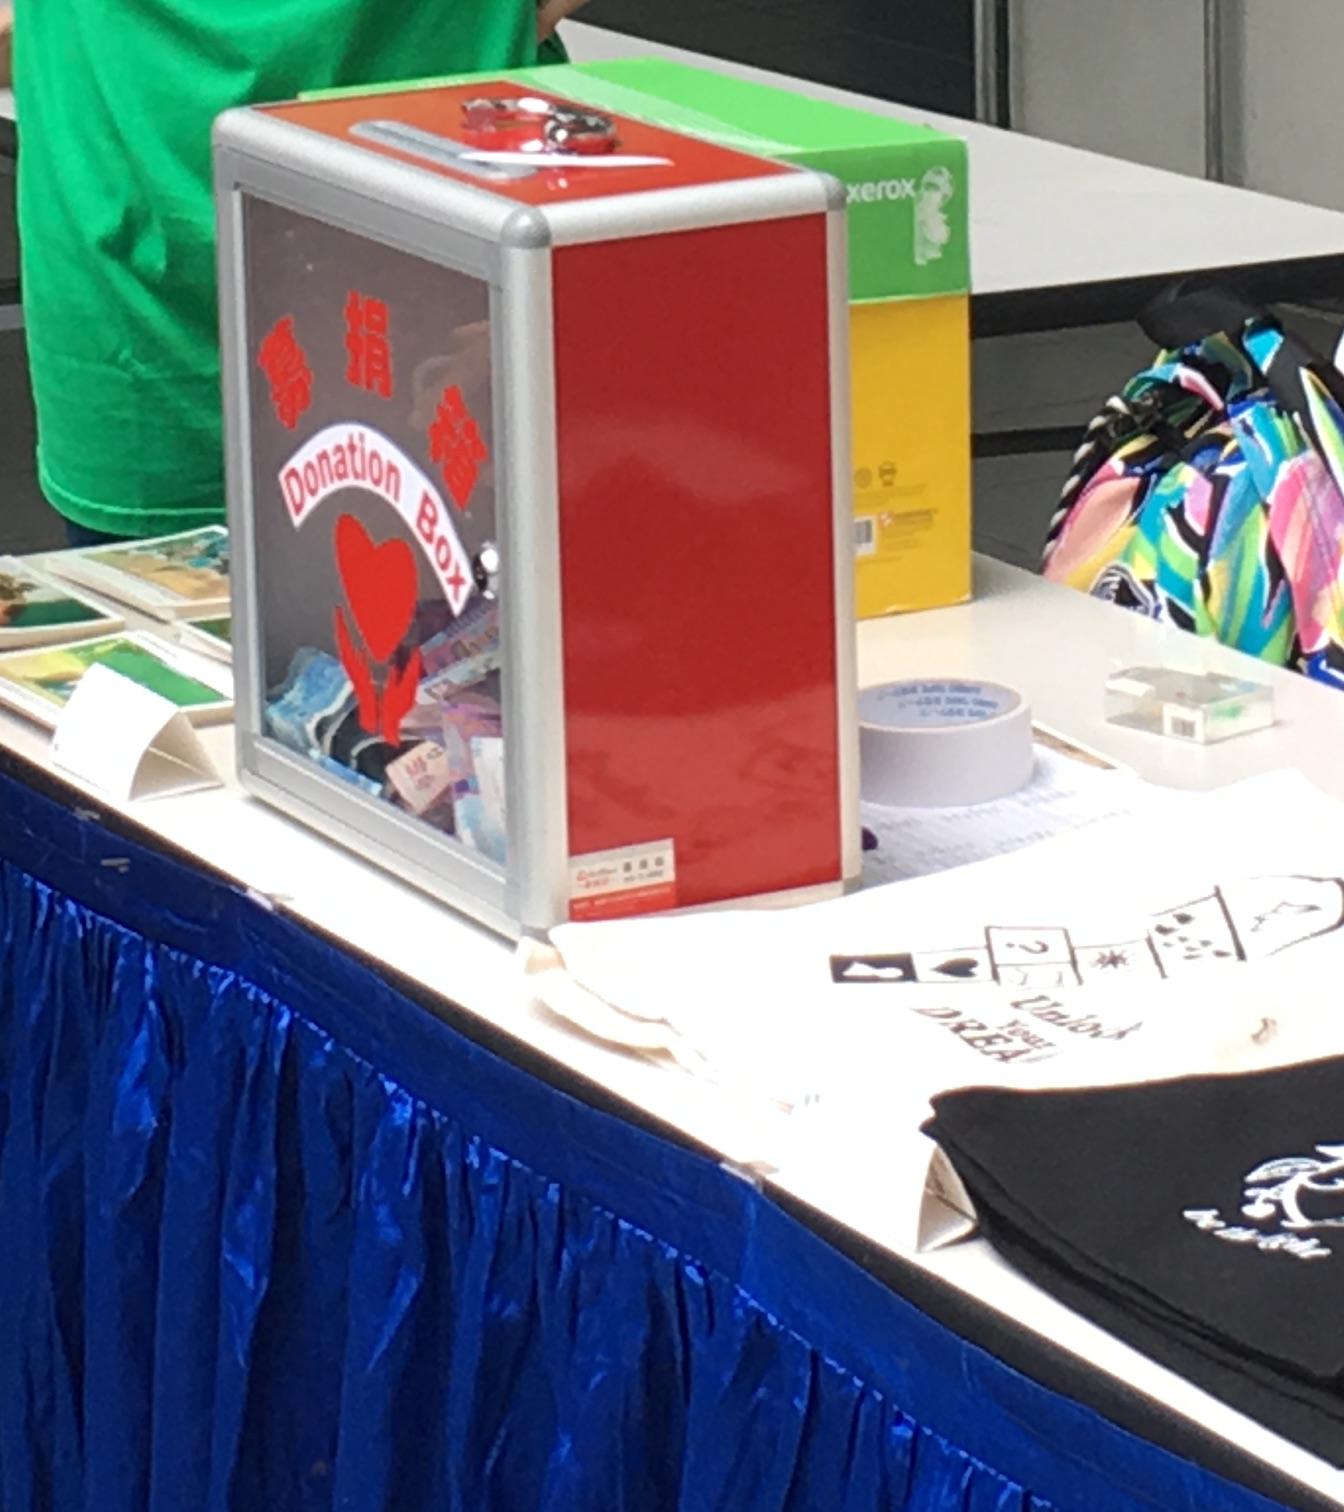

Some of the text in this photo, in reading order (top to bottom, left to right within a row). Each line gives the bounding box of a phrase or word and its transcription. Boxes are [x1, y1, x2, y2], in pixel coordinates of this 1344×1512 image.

[846, 177, 916, 204] xerox
[283, 431, 468, 603] Donation Box
